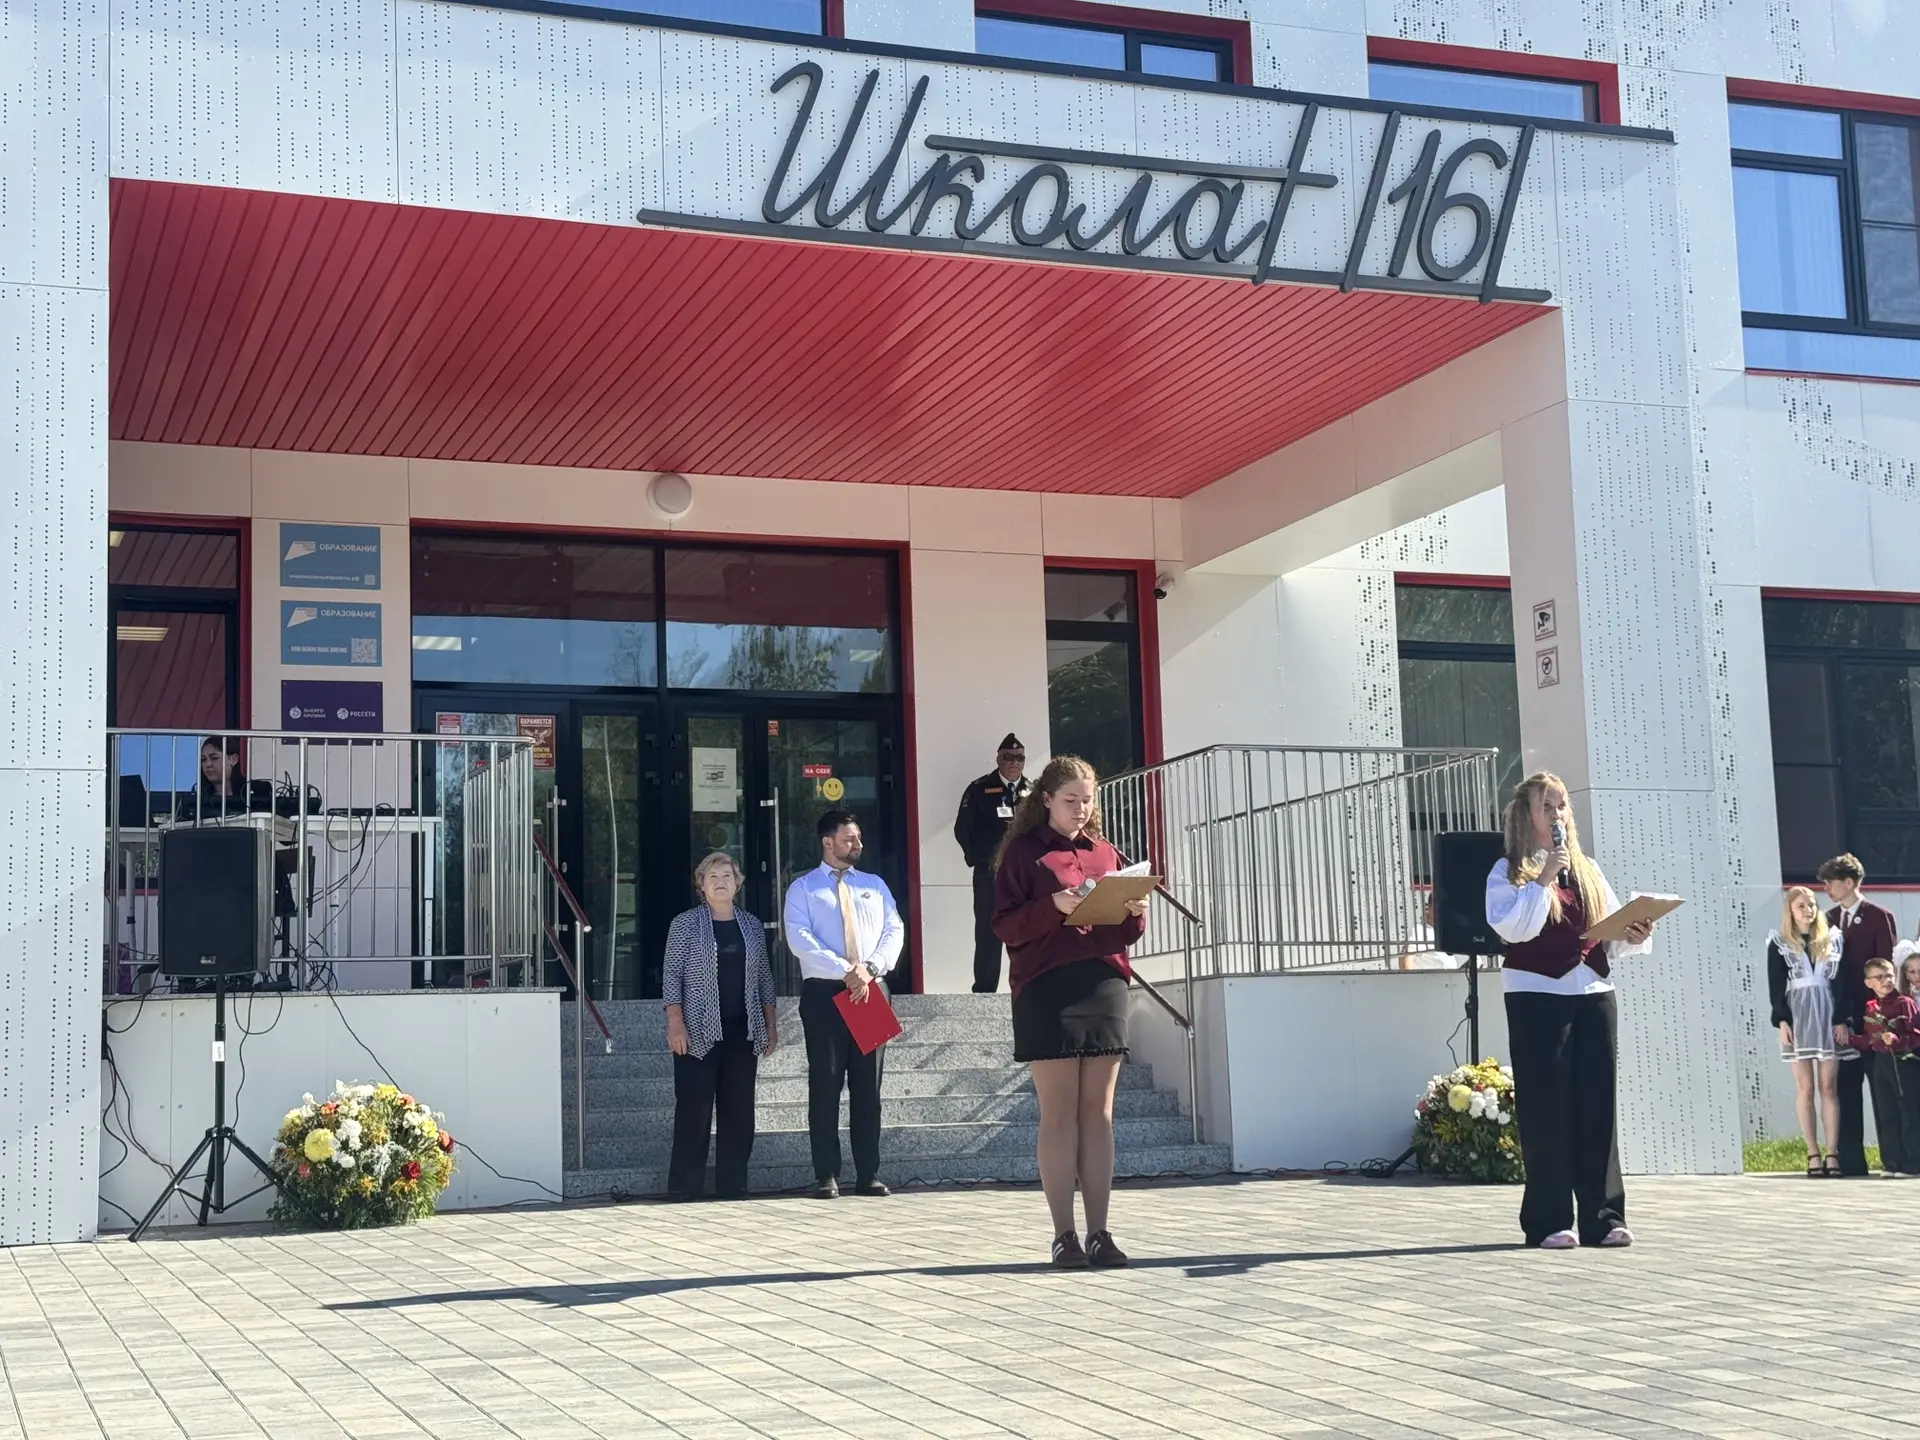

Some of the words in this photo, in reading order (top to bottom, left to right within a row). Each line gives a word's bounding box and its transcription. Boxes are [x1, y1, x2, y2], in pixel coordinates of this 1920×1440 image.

[319, 543, 378, 553] ОБРАЗОВАНИЕ
[320, 609, 377, 618] ОБРАЗОВАНИЕ
[349, 710, 376, 718] РОССЕТИ
[520, 717, 552, 725] ОХРАНЯЕТСЯ
